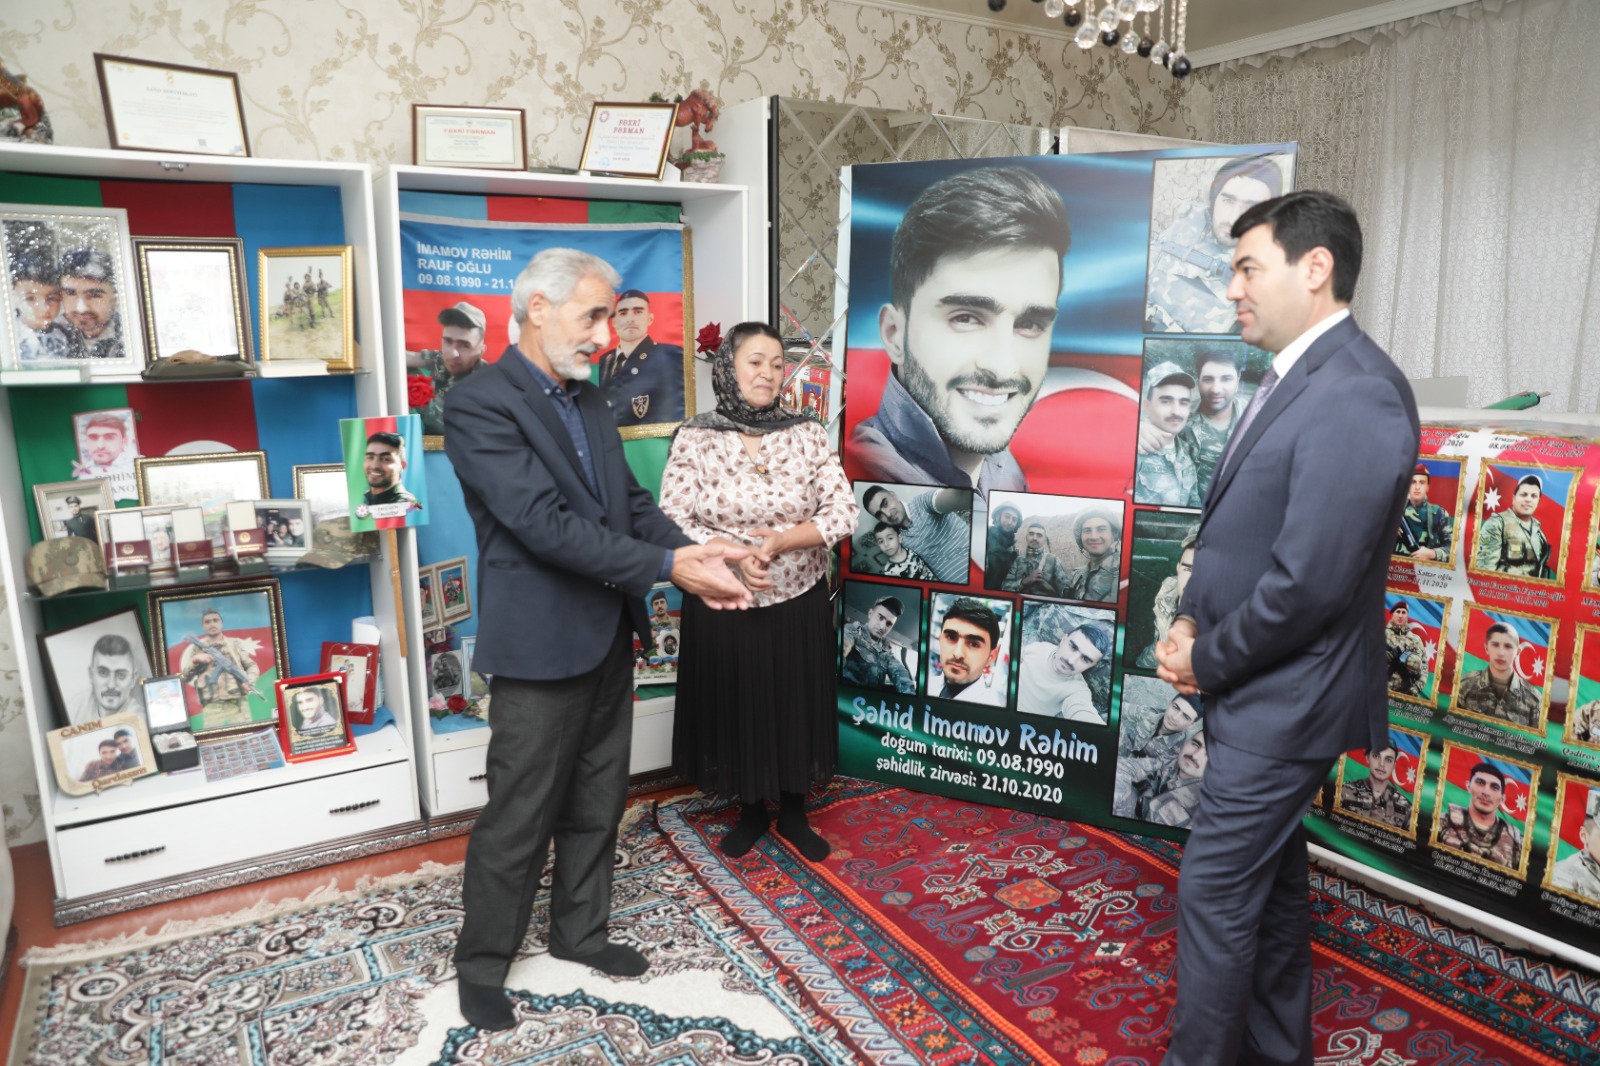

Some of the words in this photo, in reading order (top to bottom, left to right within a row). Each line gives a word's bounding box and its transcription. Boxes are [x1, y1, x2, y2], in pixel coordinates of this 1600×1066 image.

[416, 241, 468, 259] İMAMOV
[472, 248, 512, 260] RƏHİM
[418, 258, 453, 271] RAUF
[456, 261, 492, 274] OĞLU
[418, 273, 481, 288] 09.08.1990
[491, 278, 514, 289] 21.1
[852, 696, 914, 732] Şəhid
[1020, 723, 1098, 764] Rəhim
[881, 732, 927, 755] doğum
[932, 740, 972, 762] tarixi:
[976, 748, 1064, 779] 09.08.1990
[876, 757, 926, 778] şəhidlik
[930, 766, 976, 788] zirvəsi:
[982, 773, 1063, 804] 21.10.2020
